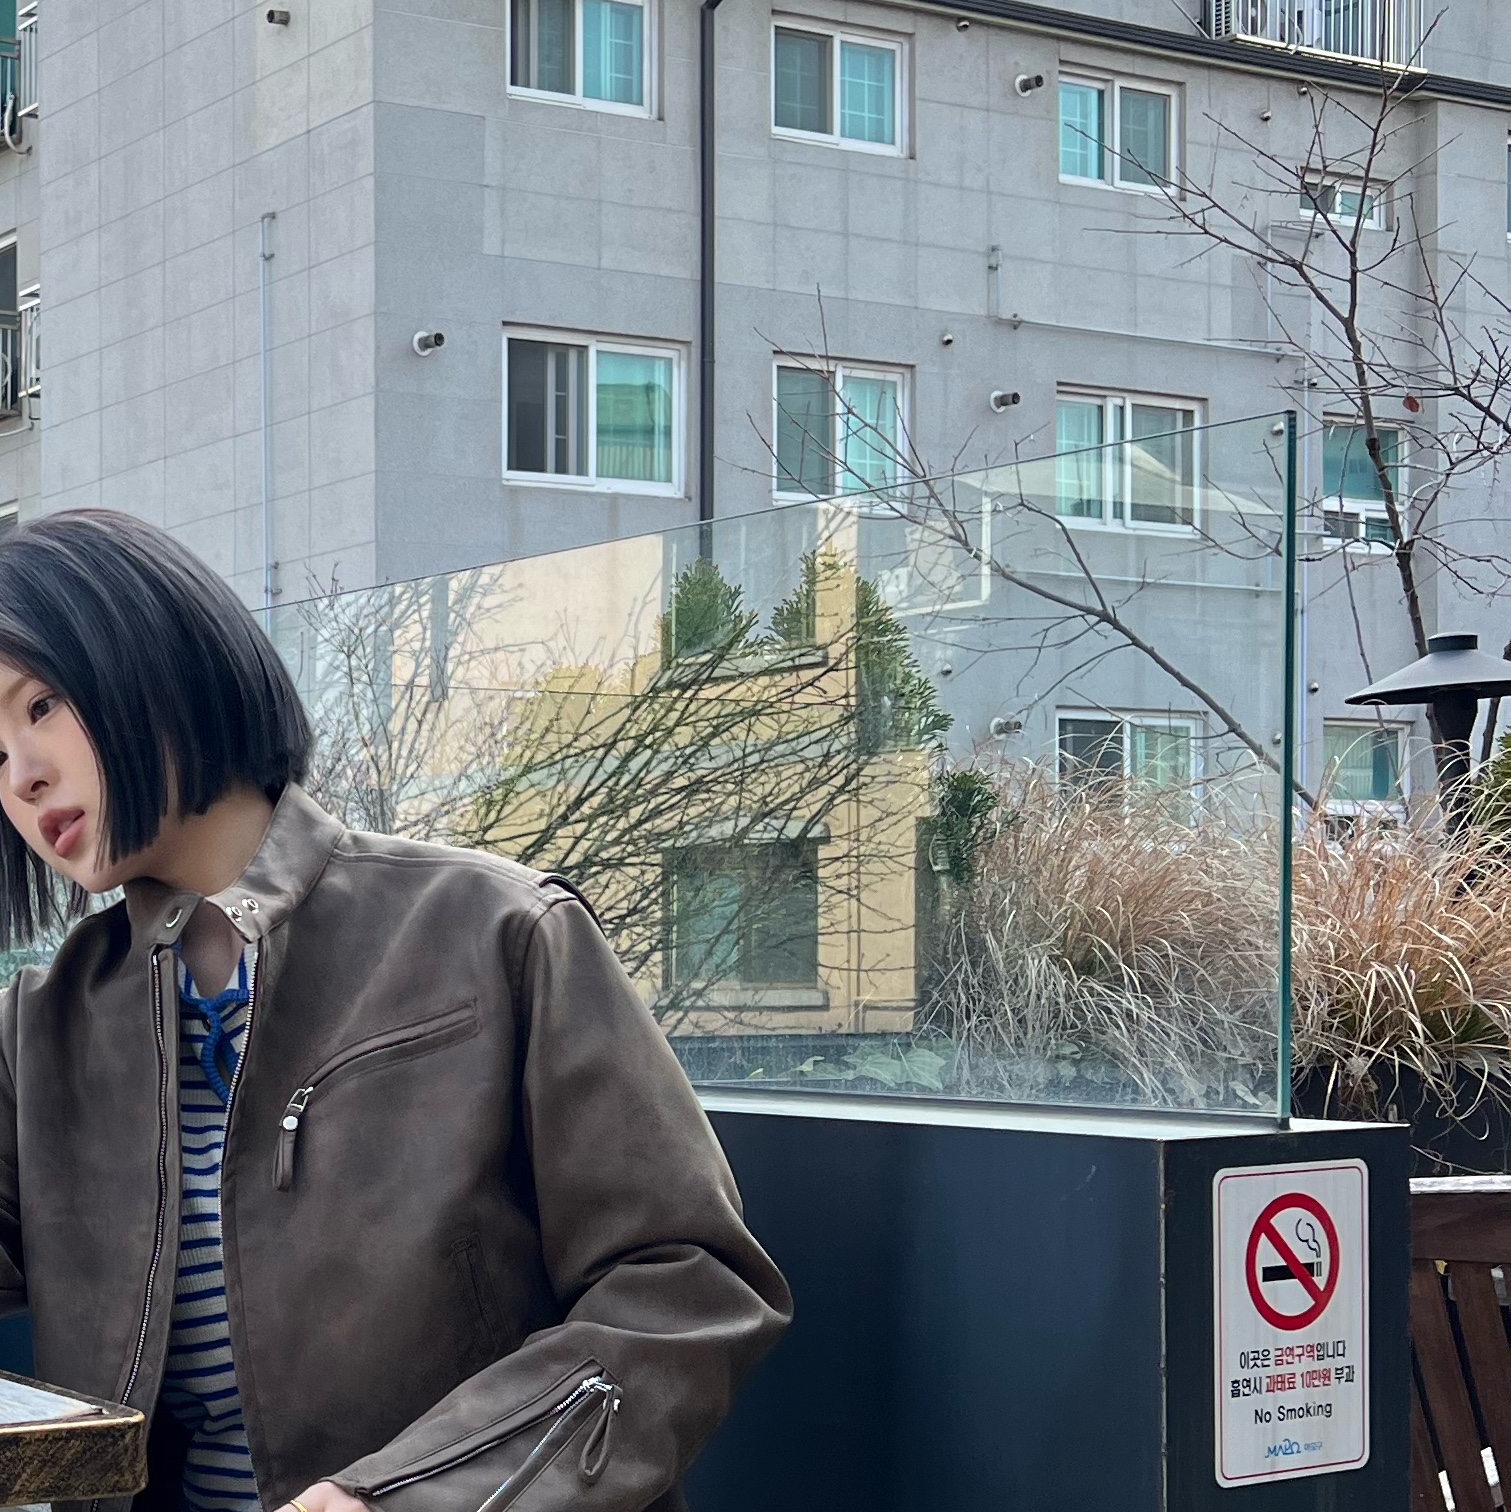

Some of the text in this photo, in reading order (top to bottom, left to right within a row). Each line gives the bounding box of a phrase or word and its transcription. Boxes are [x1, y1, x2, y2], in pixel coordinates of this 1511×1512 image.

[1239, 1340, 1346, 1370] 이곳은 금연구역입니다
[1230, 1364, 1355, 1398] 흡연시 과태료 10만원 부과
[1254, 1401, 1332, 1424] No Smoking
